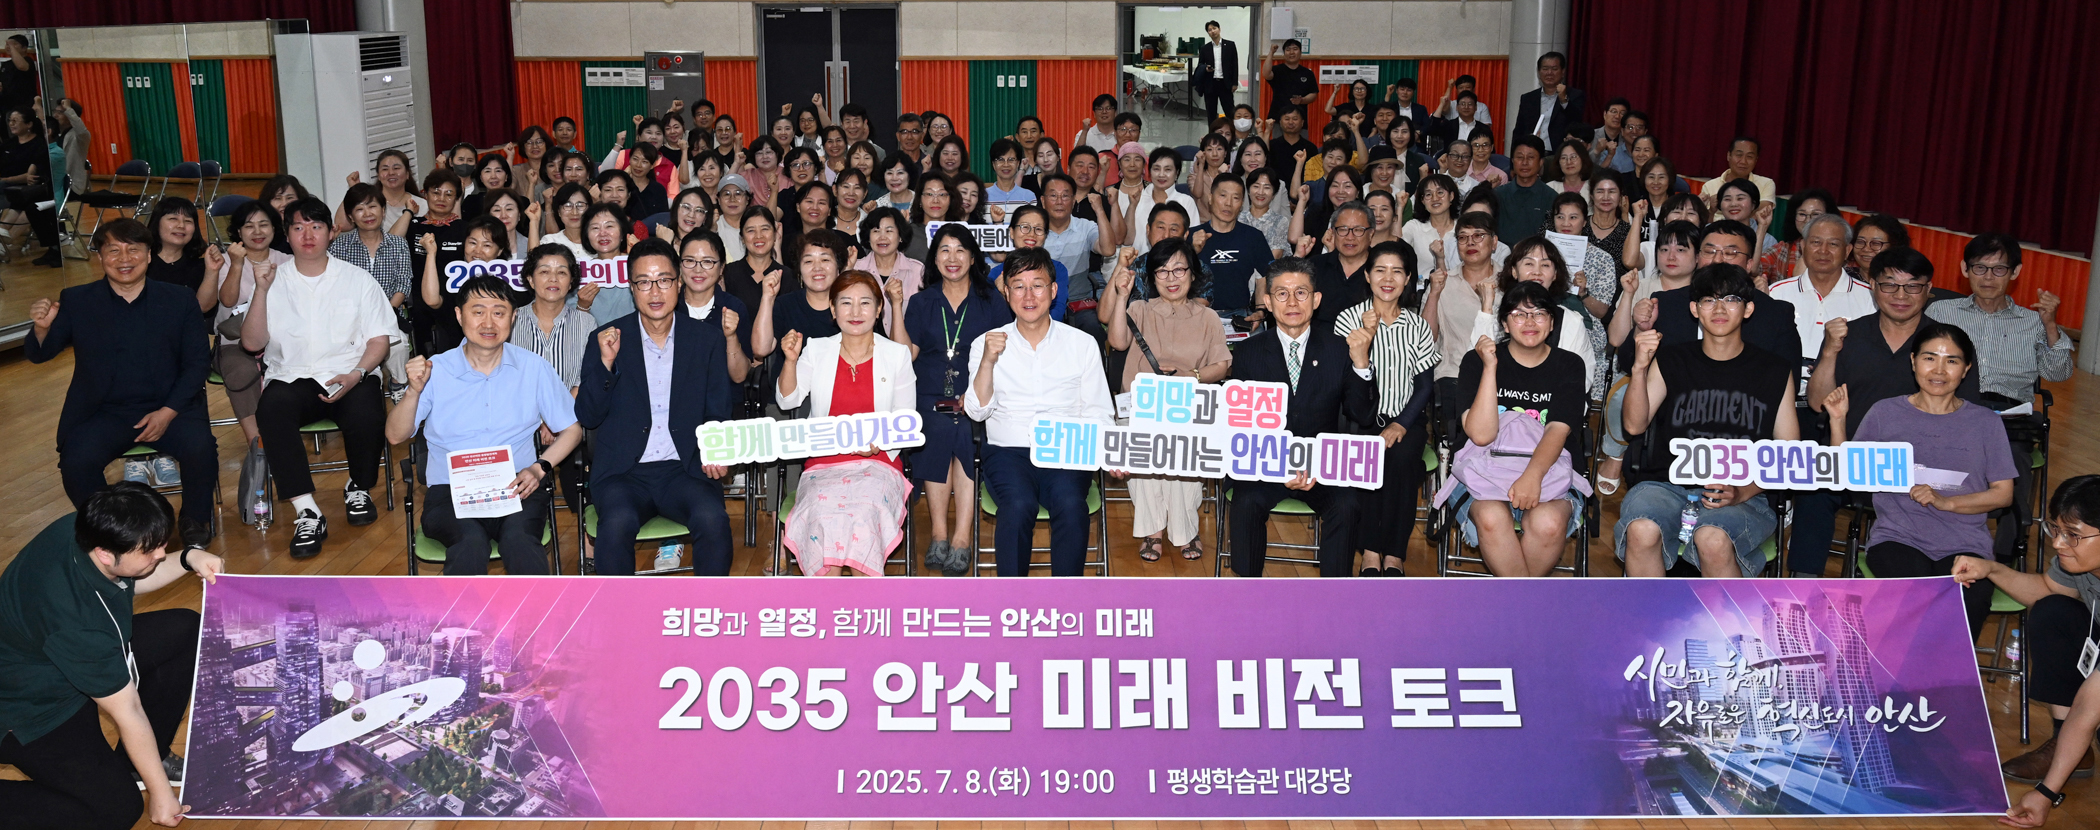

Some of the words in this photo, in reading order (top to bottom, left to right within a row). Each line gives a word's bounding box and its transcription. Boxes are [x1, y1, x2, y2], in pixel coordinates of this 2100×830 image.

[449, 263, 524, 289] 2035
[1135, 378, 1218, 425] 희망과
[1225, 384, 1284, 430] 열정
[1672, 389, 1767, 434] GARMENT
[701, 422, 773, 462] 함께
[779, 414, 920, 454] 만들어가요
[1034, 419, 1099, 466] 함께
[1104, 430, 1223, 473] 만들어가는
[1231, 432, 1312, 479] 안산의
[1319, 438, 1379, 484] 미래
[1675, 443, 1749, 480] 2035
[1757, 445, 1840, 485] 안산의
[1847, 447, 1908, 487] 미래
[662, 608, 749, 637] 희망과
[758, 608, 827, 639] 열정,
[833, 608, 891, 637] 함께
[902, 608, 992, 637] 만드는
[1000, 608, 1084, 637] 안산의
[1095, 608, 1154, 638] 미래
[658, 666, 848, 731] 2035
[872, 661, 1018, 731] 안산
[1042, 657, 1189, 729] 미래
[1216, 658, 1364, 729] 비전
[1390, 667, 1522, 728] 토크
[1623, 646, 1718, 702] 시민과
[1715, 650, 1784, 691] 함께,
[1659, 700, 1746, 743] 자유로운
[1757, 698, 1854, 742] 혁신도시
[1864, 695, 1947, 733] 안산
[856, 769, 929, 794] 2025.
[935, 769, 958, 794] 7.
[965, 767, 1031, 797] 8.(화)
[1040, 769, 1115, 794] 19:00
[1167, 767, 1280, 795] 평생학습관
[1284, 767, 1352, 795] 대강당
